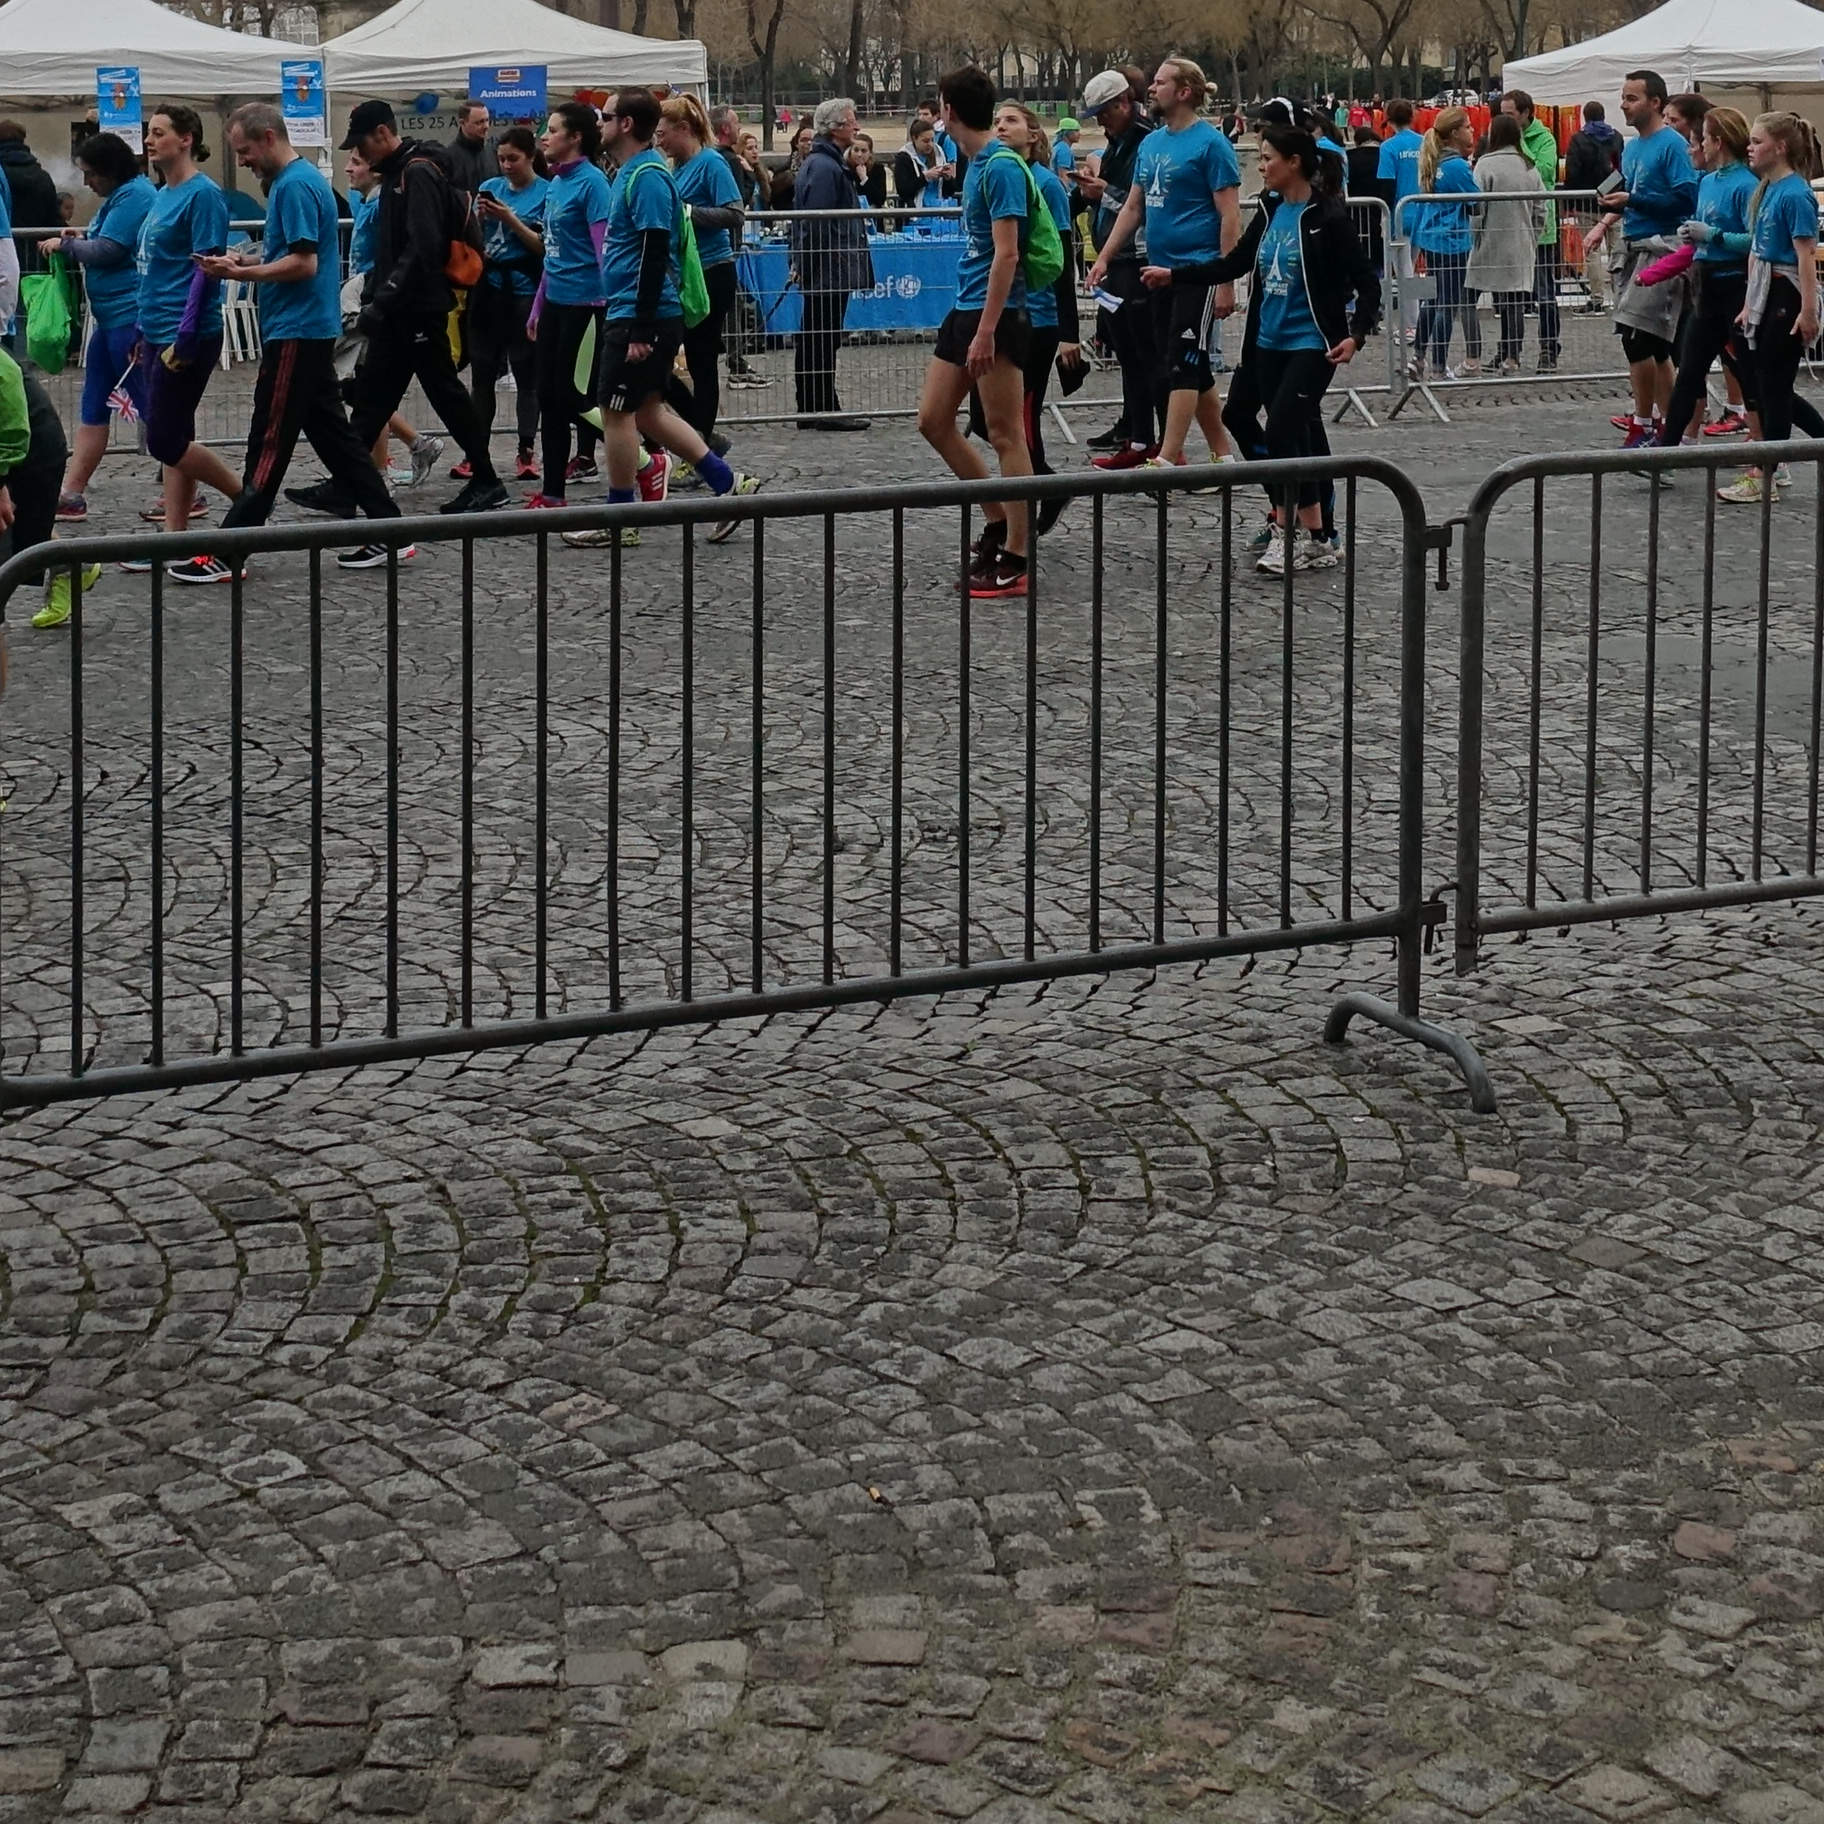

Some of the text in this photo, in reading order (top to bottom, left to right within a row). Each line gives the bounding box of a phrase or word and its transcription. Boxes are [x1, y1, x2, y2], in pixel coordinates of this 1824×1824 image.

[479, 88, 537, 98] Animations
[401, 117, 425, 130] LES
[429, 116, 445, 129] 25
[1399, 150, 1421, 160] unice
